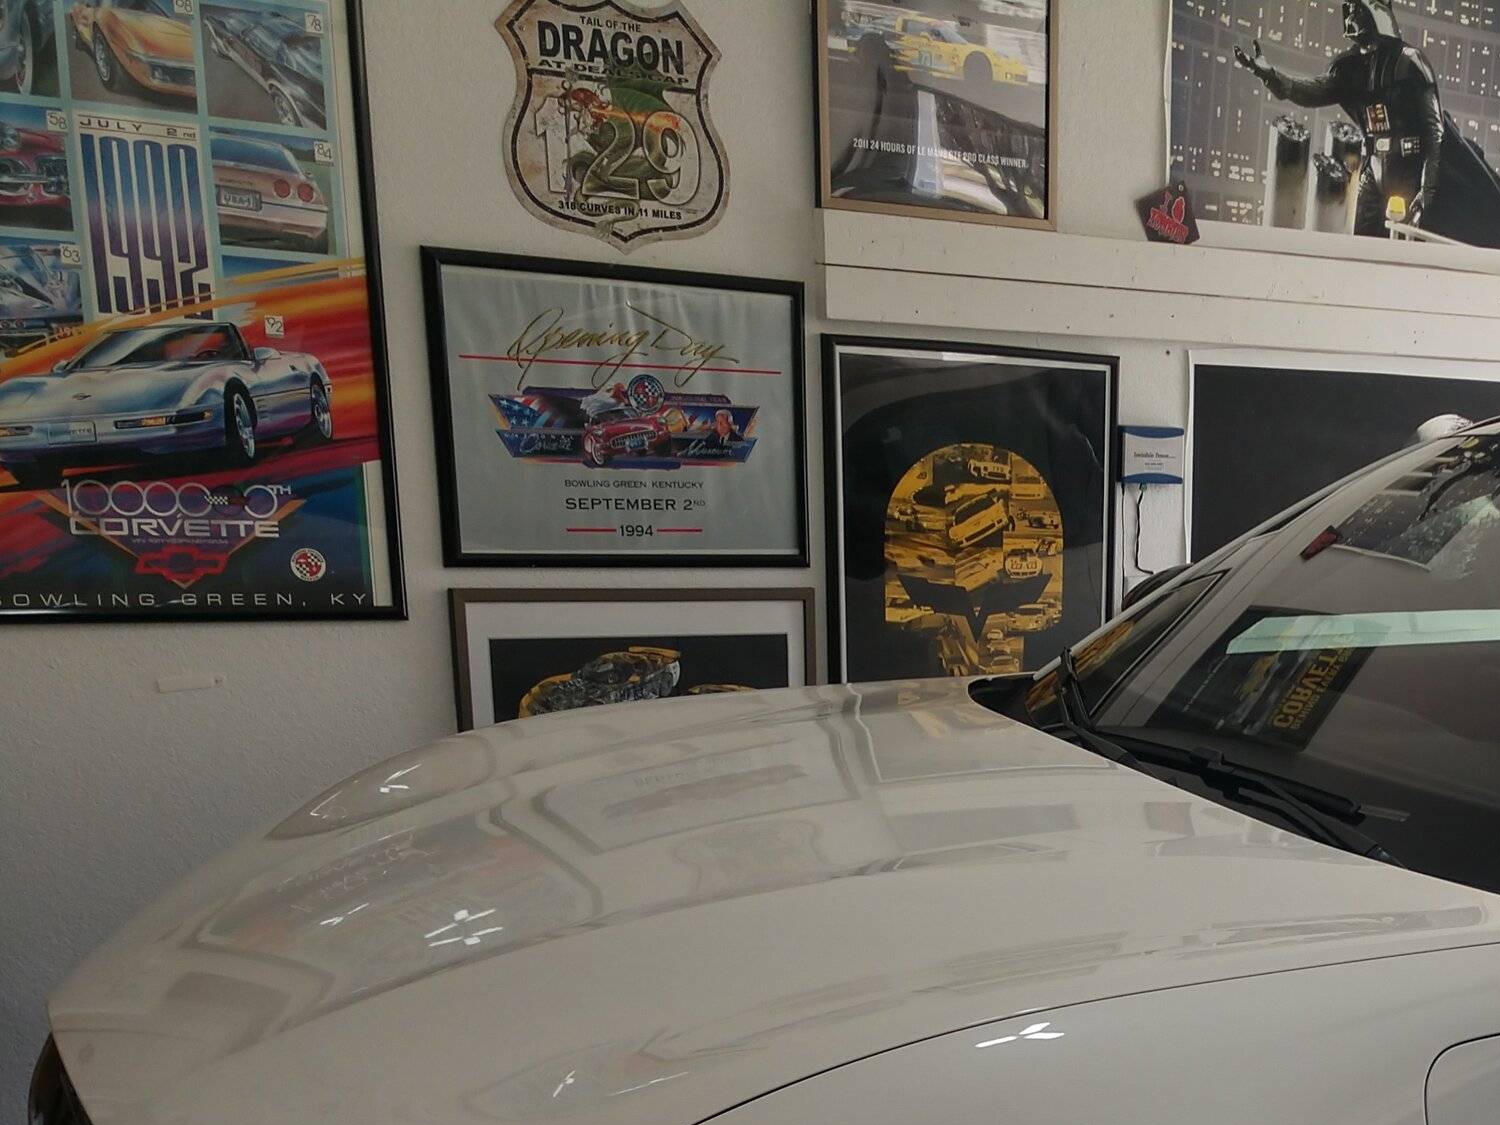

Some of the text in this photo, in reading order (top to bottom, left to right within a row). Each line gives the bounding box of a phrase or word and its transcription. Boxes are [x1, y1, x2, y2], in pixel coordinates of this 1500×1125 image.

[579, 16, 642, 33] TAIL OF THE
[537, 20, 685, 75] DRAGON
[538, 59, 566, 69] AT
[79, 118, 142, 132] JULY
[535, 97, 700, 206] 129
[853, 138, 869, 149] 2011
[870, 140, 879, 150] 24
[880, 142, 906, 153] HOURS
[907, 146, 917, 155] OF
[917, 146, 927, 156] LE
[978, 153, 1000, 165] CLASS
[579, 202, 622, 214] CURVES
[624, 206, 636, 216] IN
[638, 207, 649, 217] 11
[651, 209, 682, 220] MILES
[625, 299, 740, 388] Day
[564, 479, 704, 489] BOWLING GREEN KENTUCKY
[565, 498, 677, 511] SEPTEMBER
[69, 516, 281, 538] CORVETTE
[619, 525, 654, 537] 1994
[0, 592, 157, 608] OWLING
[330, 592, 368, 606] KY
